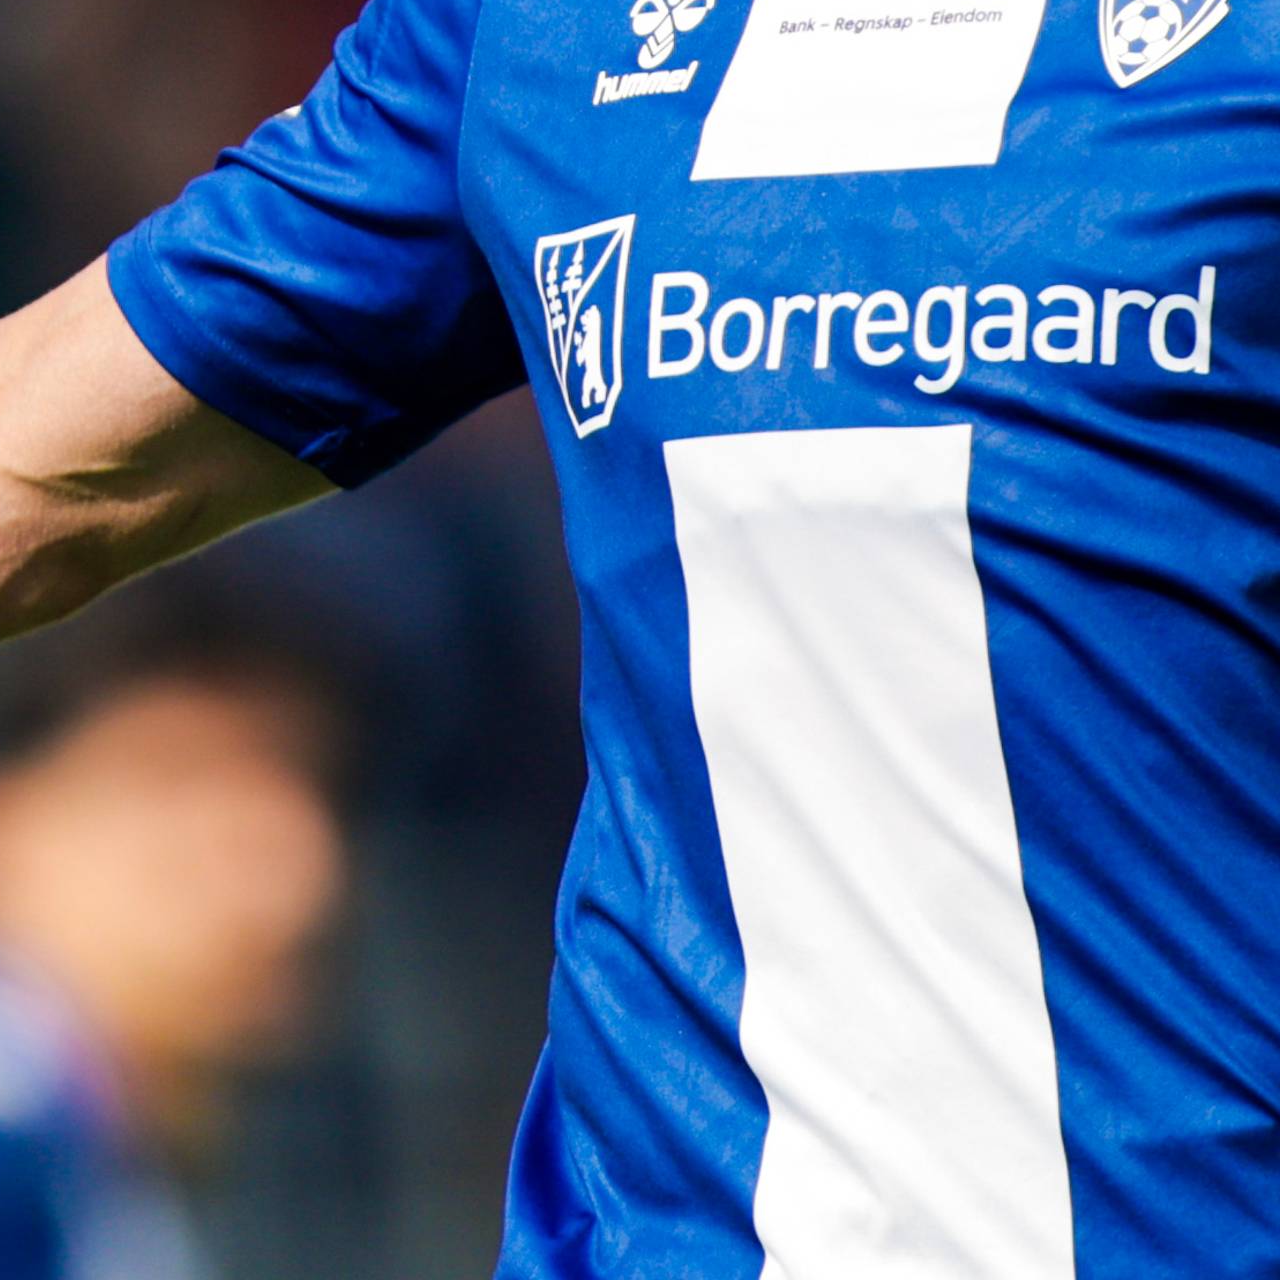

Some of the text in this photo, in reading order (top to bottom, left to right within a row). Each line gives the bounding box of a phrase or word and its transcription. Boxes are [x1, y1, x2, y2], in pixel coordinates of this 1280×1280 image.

[779, 19, 817, 35] Bank
[834, 14, 914, 35] Regnskap
[930, 8, 1003, 27] Eiendom
[592, 59, 699, 106] hummel
[648, 265, 1216, 395] Borregaard
